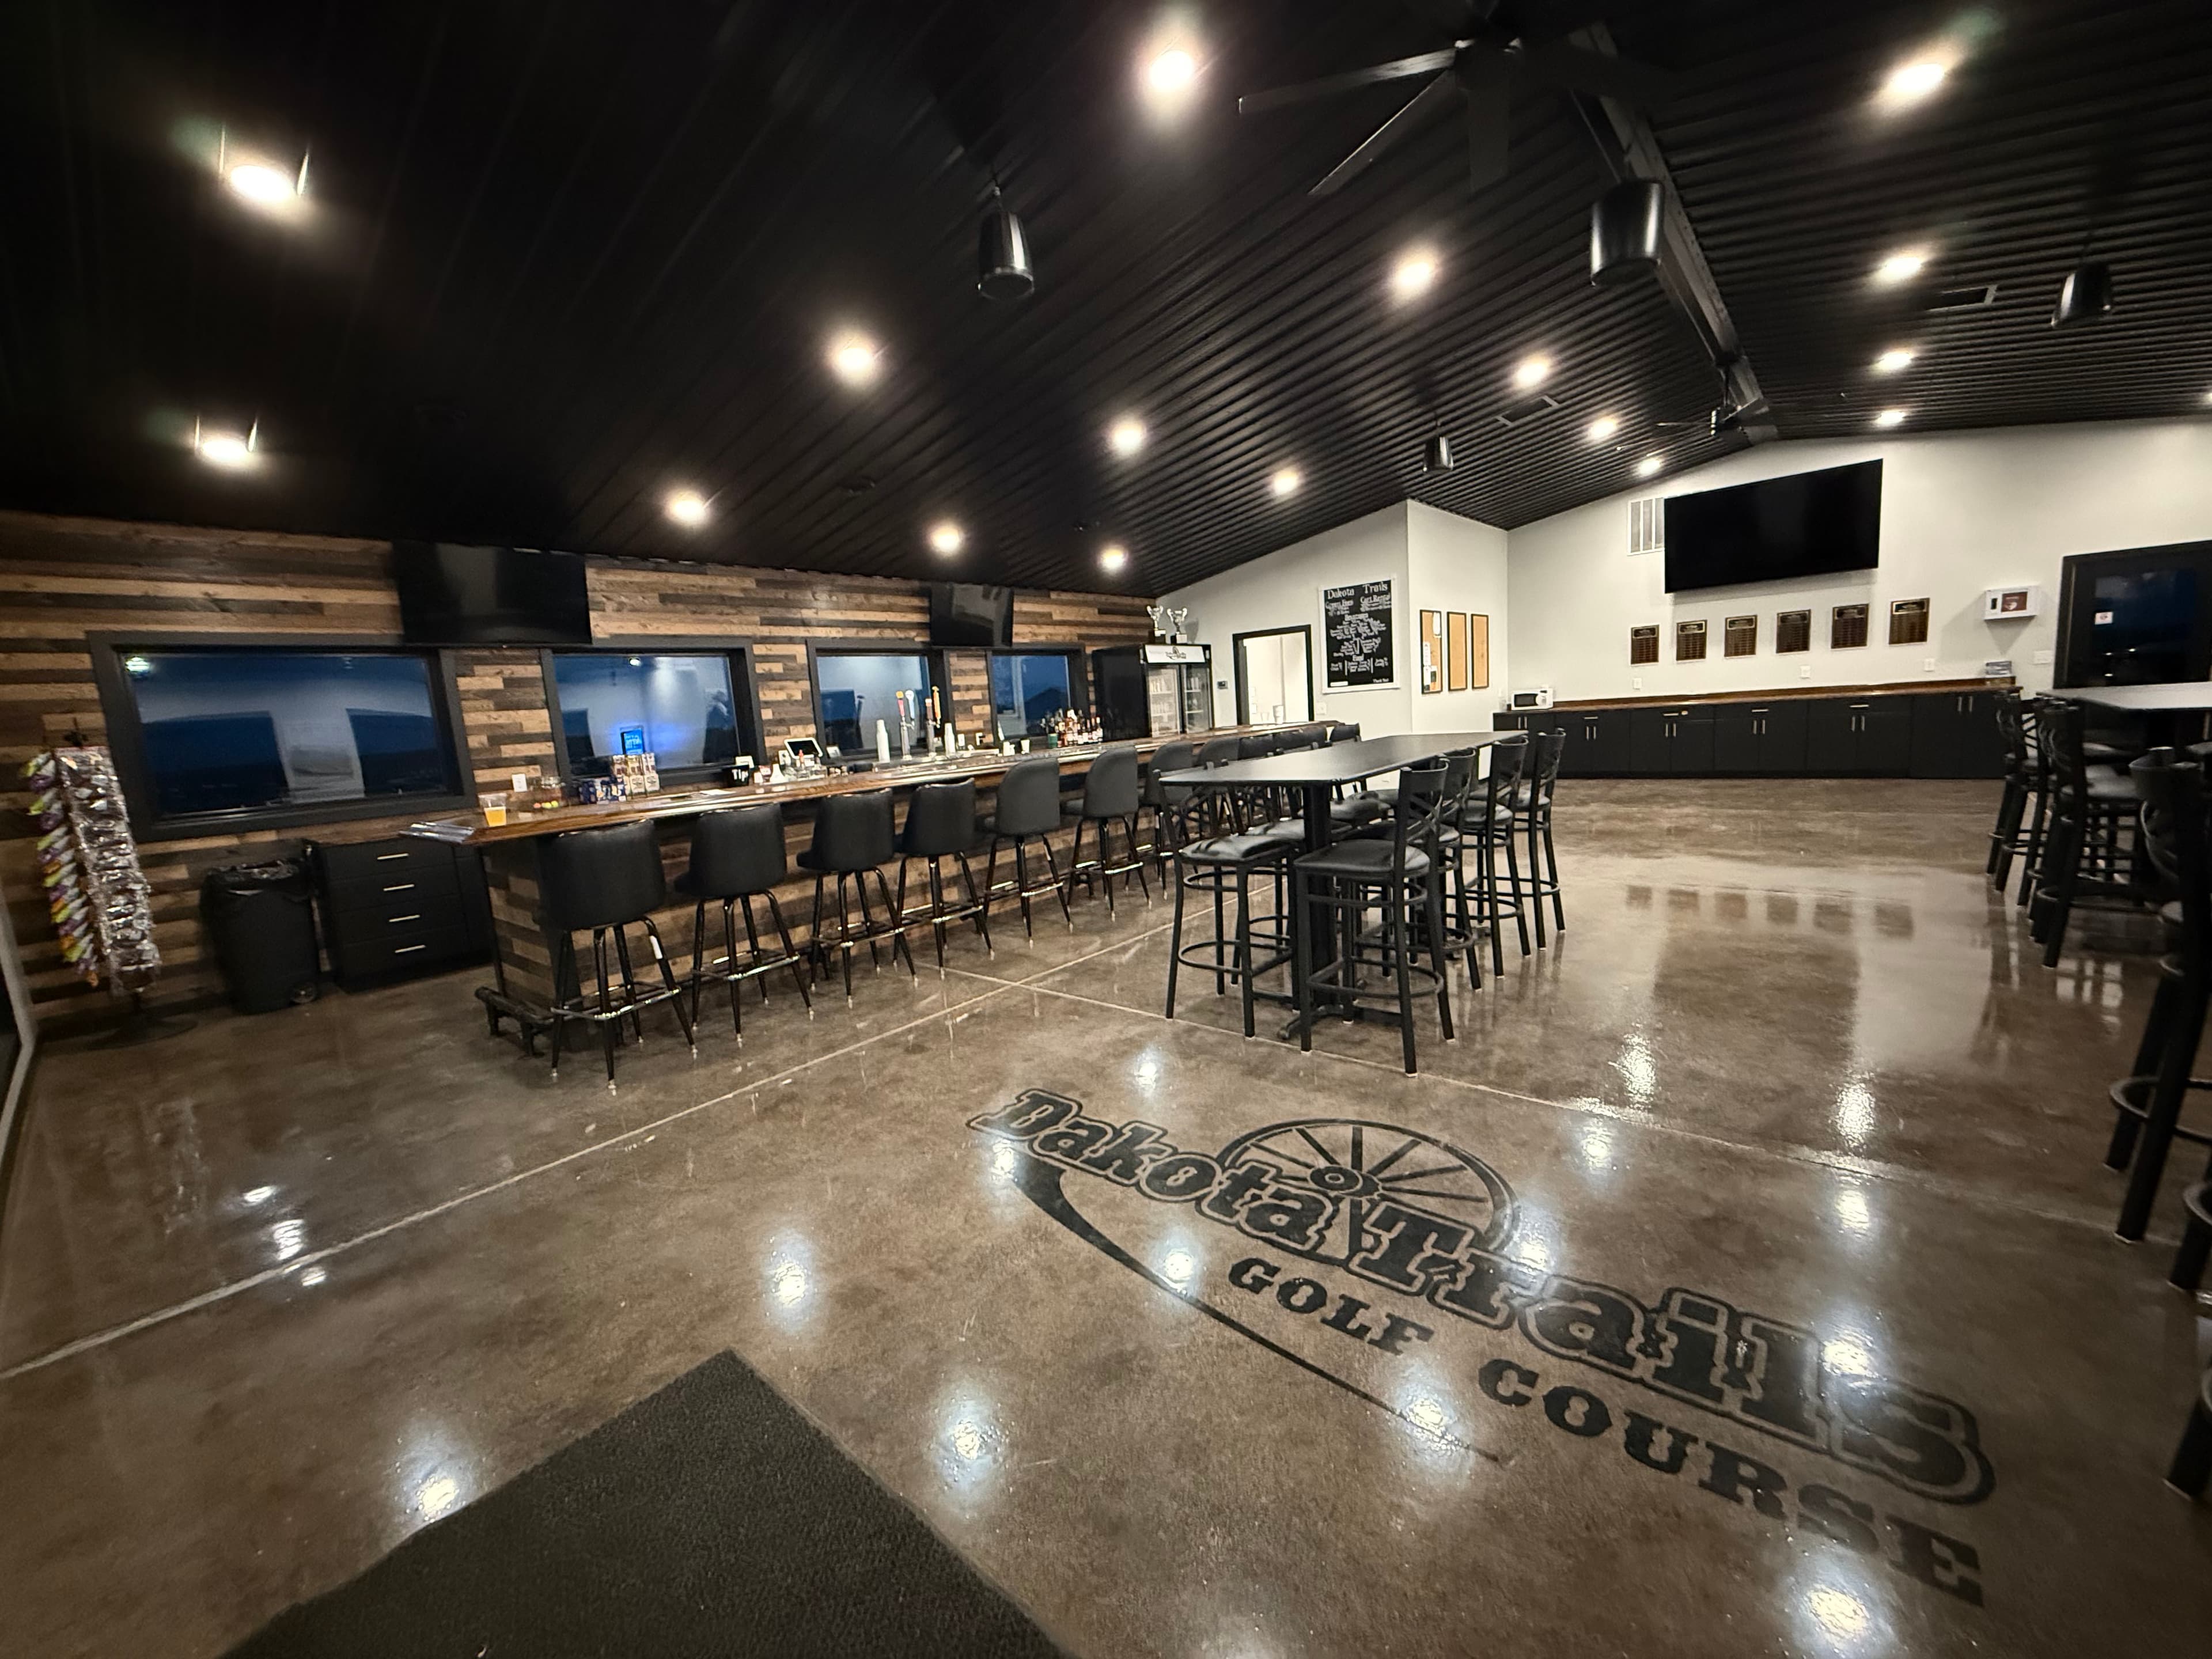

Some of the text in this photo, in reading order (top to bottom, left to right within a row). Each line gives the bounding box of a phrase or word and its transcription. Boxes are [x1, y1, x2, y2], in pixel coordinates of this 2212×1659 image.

[1327, 581, 1388, 599] Dakota Trails
[966, 1088, 1997, 1505] Dakota Trails
[1228, 1257, 1983, 1607] GOLF COURSE
